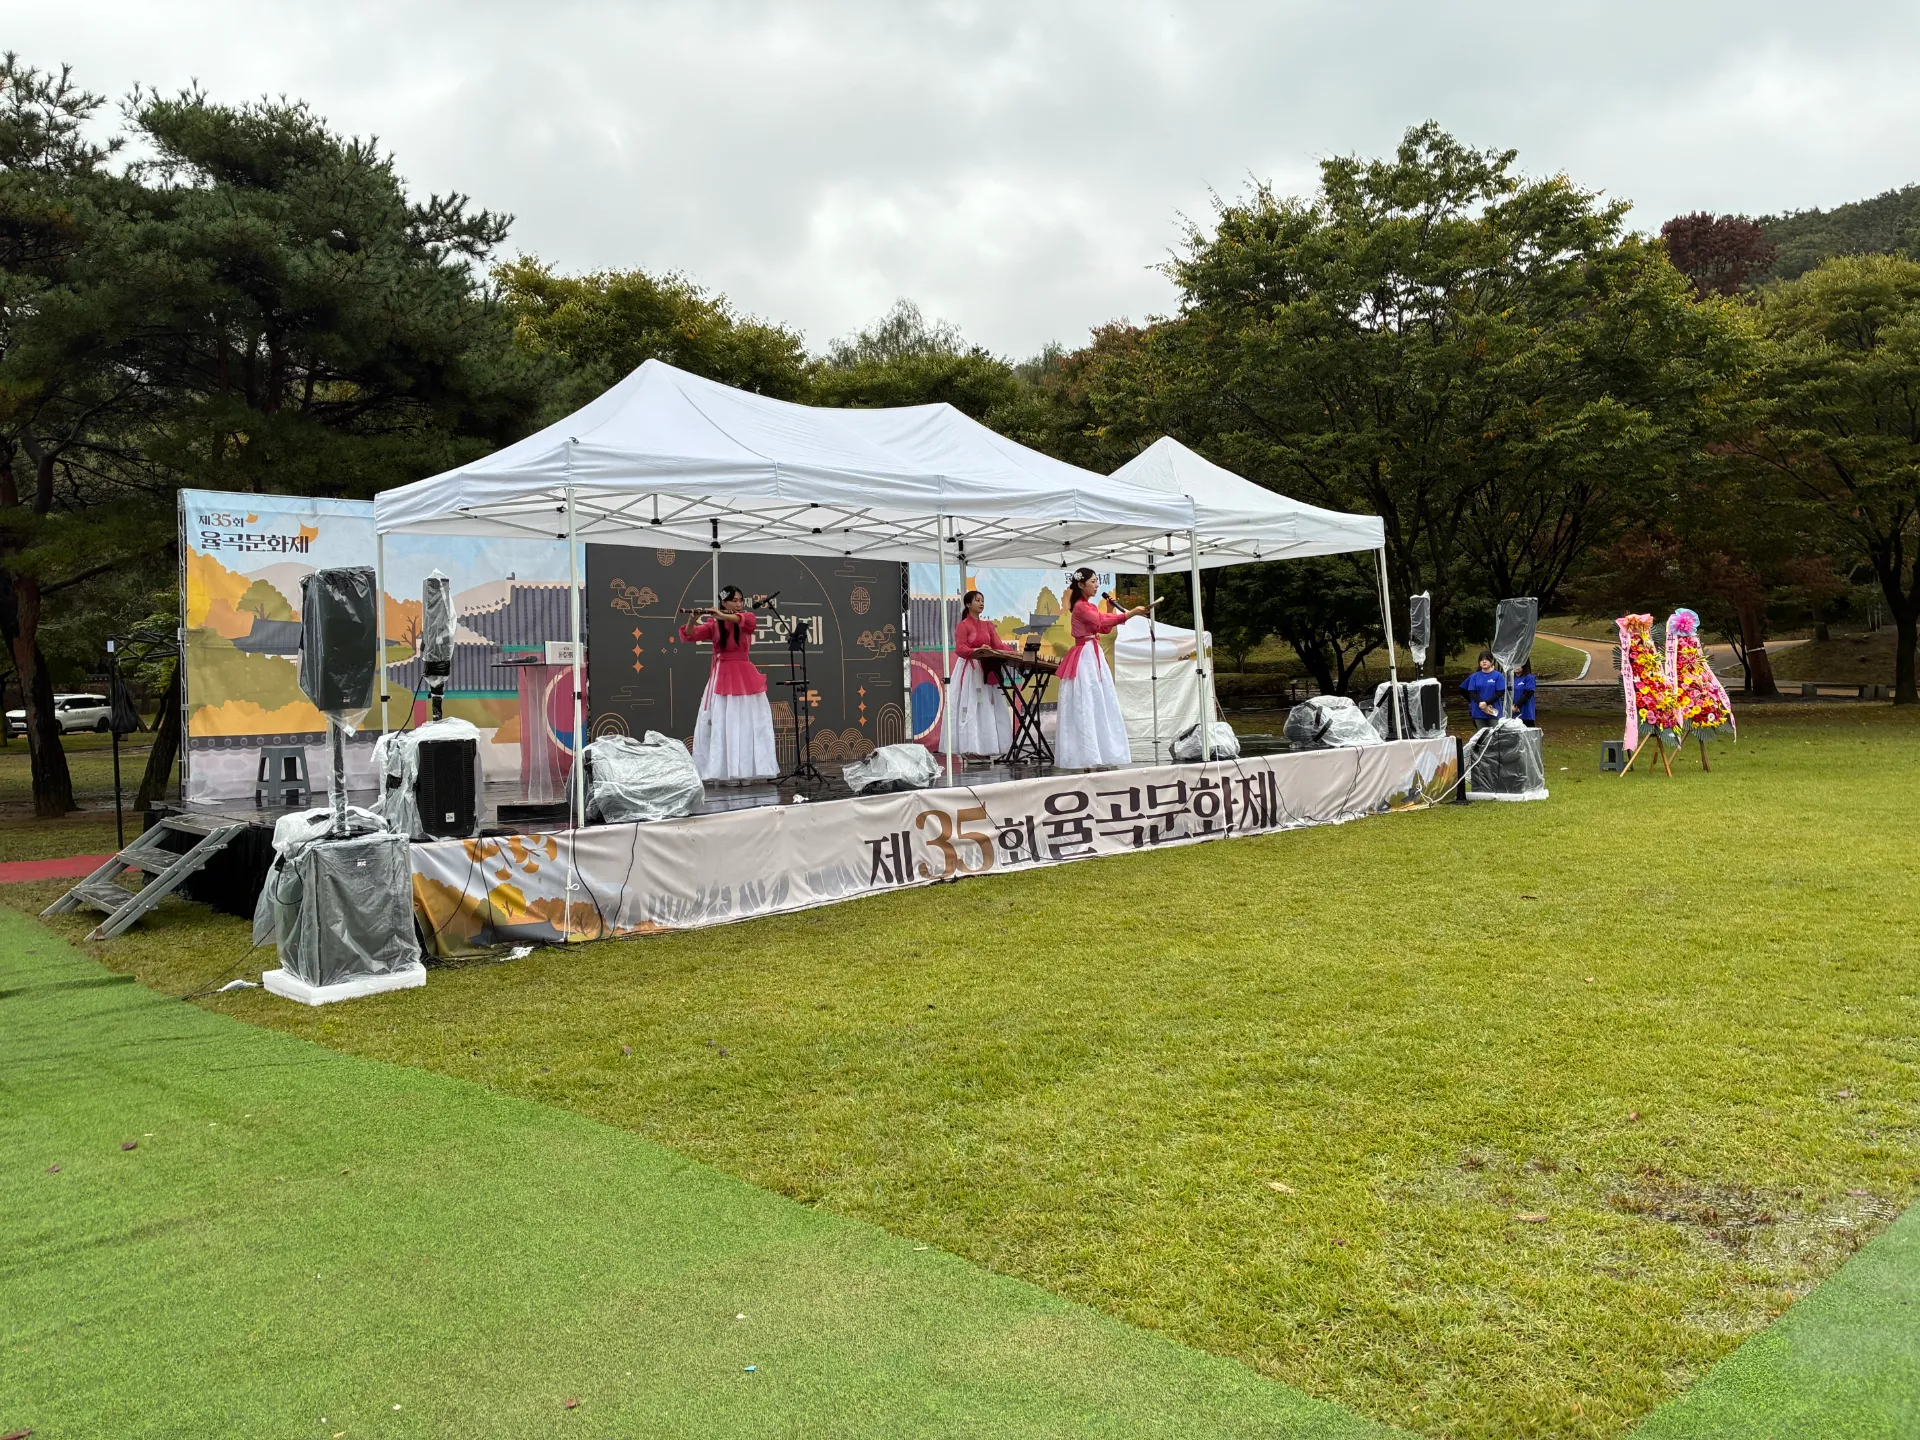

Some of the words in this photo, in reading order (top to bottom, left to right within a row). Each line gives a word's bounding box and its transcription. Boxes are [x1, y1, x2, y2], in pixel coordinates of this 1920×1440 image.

[198, 512, 244, 528] 제35회
[200, 530, 309, 554] 율곡문화제
[696, 614, 823, 646] 문화제
[864, 801, 1041, 886] 제35회
[1042, 770, 1278, 861] 율곡문화제
